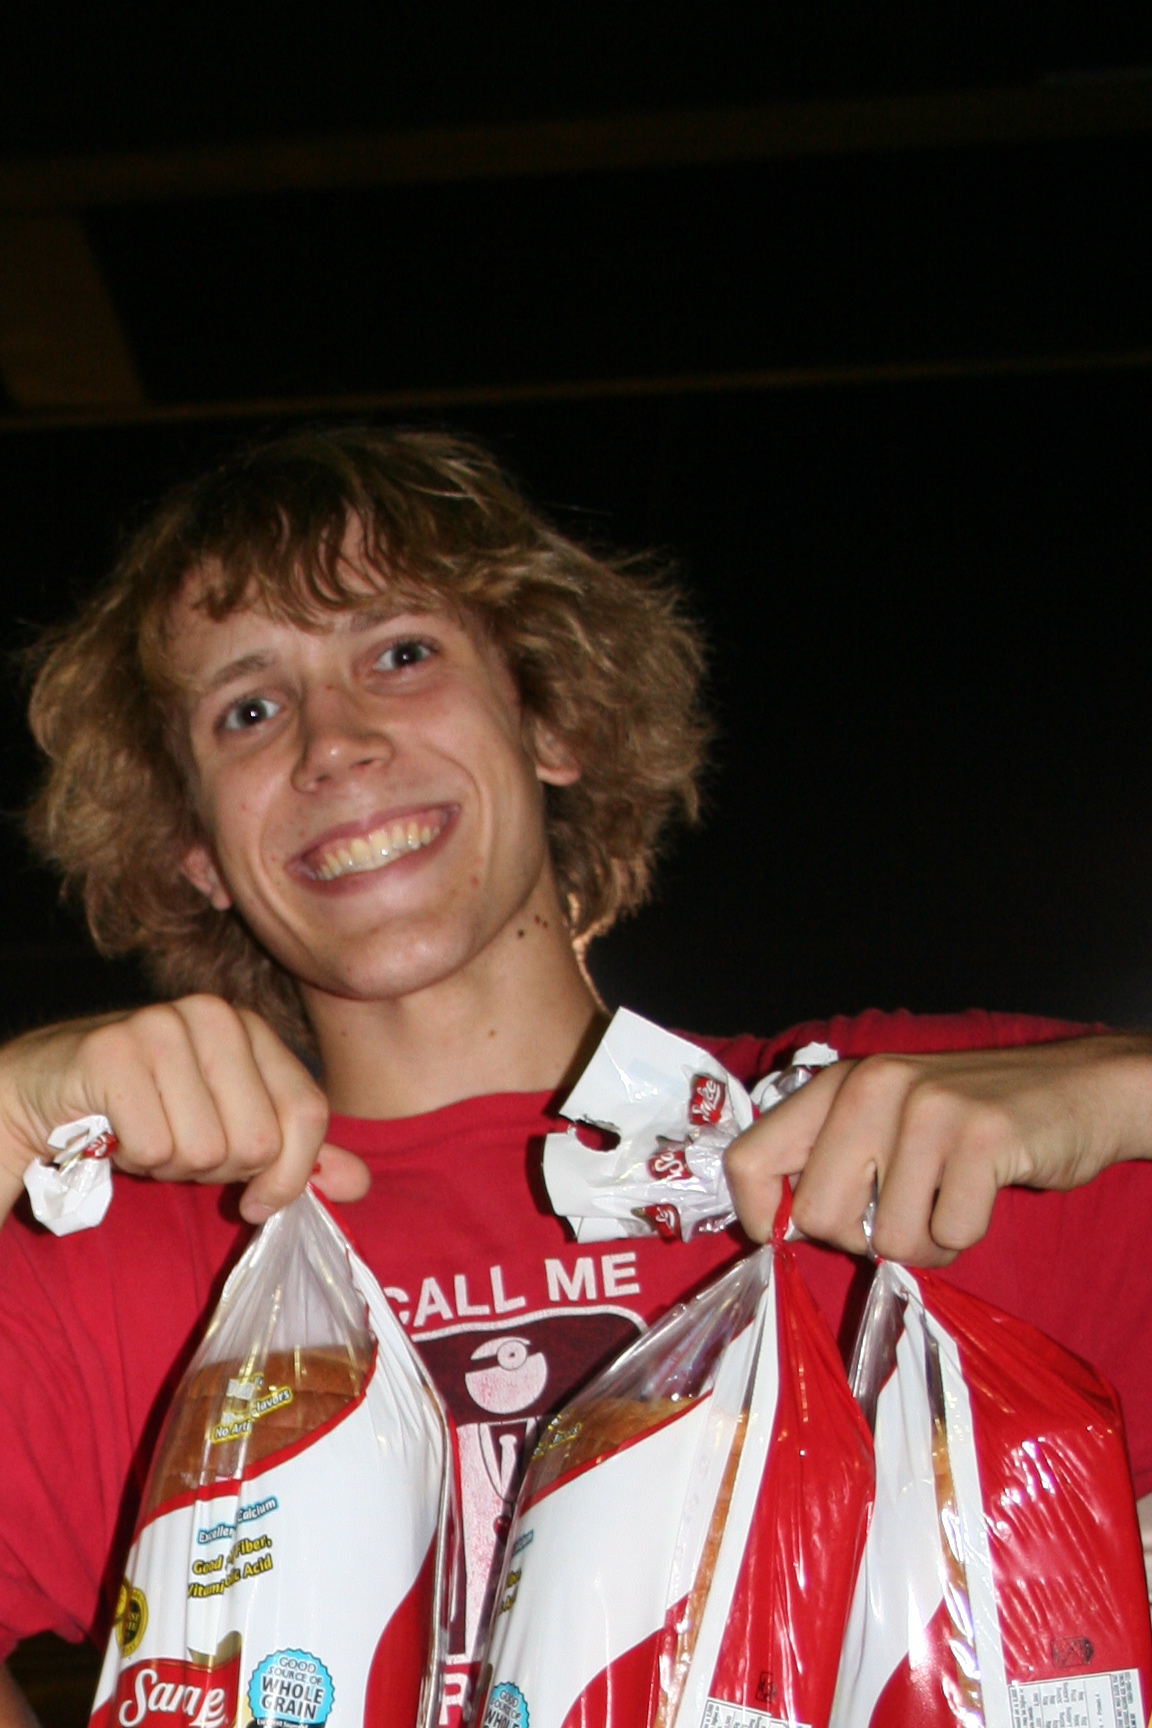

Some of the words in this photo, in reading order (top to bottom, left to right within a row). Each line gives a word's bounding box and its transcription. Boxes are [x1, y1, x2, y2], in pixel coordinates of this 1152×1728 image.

[544, 1251, 642, 1303] ME
[268, 1664, 307, 1684] SOURCE
[279, 1656, 317, 1674] GOOD
[261, 1677, 324, 1705] WHOLE
[261, 1694, 318, 1720] GRAIN
